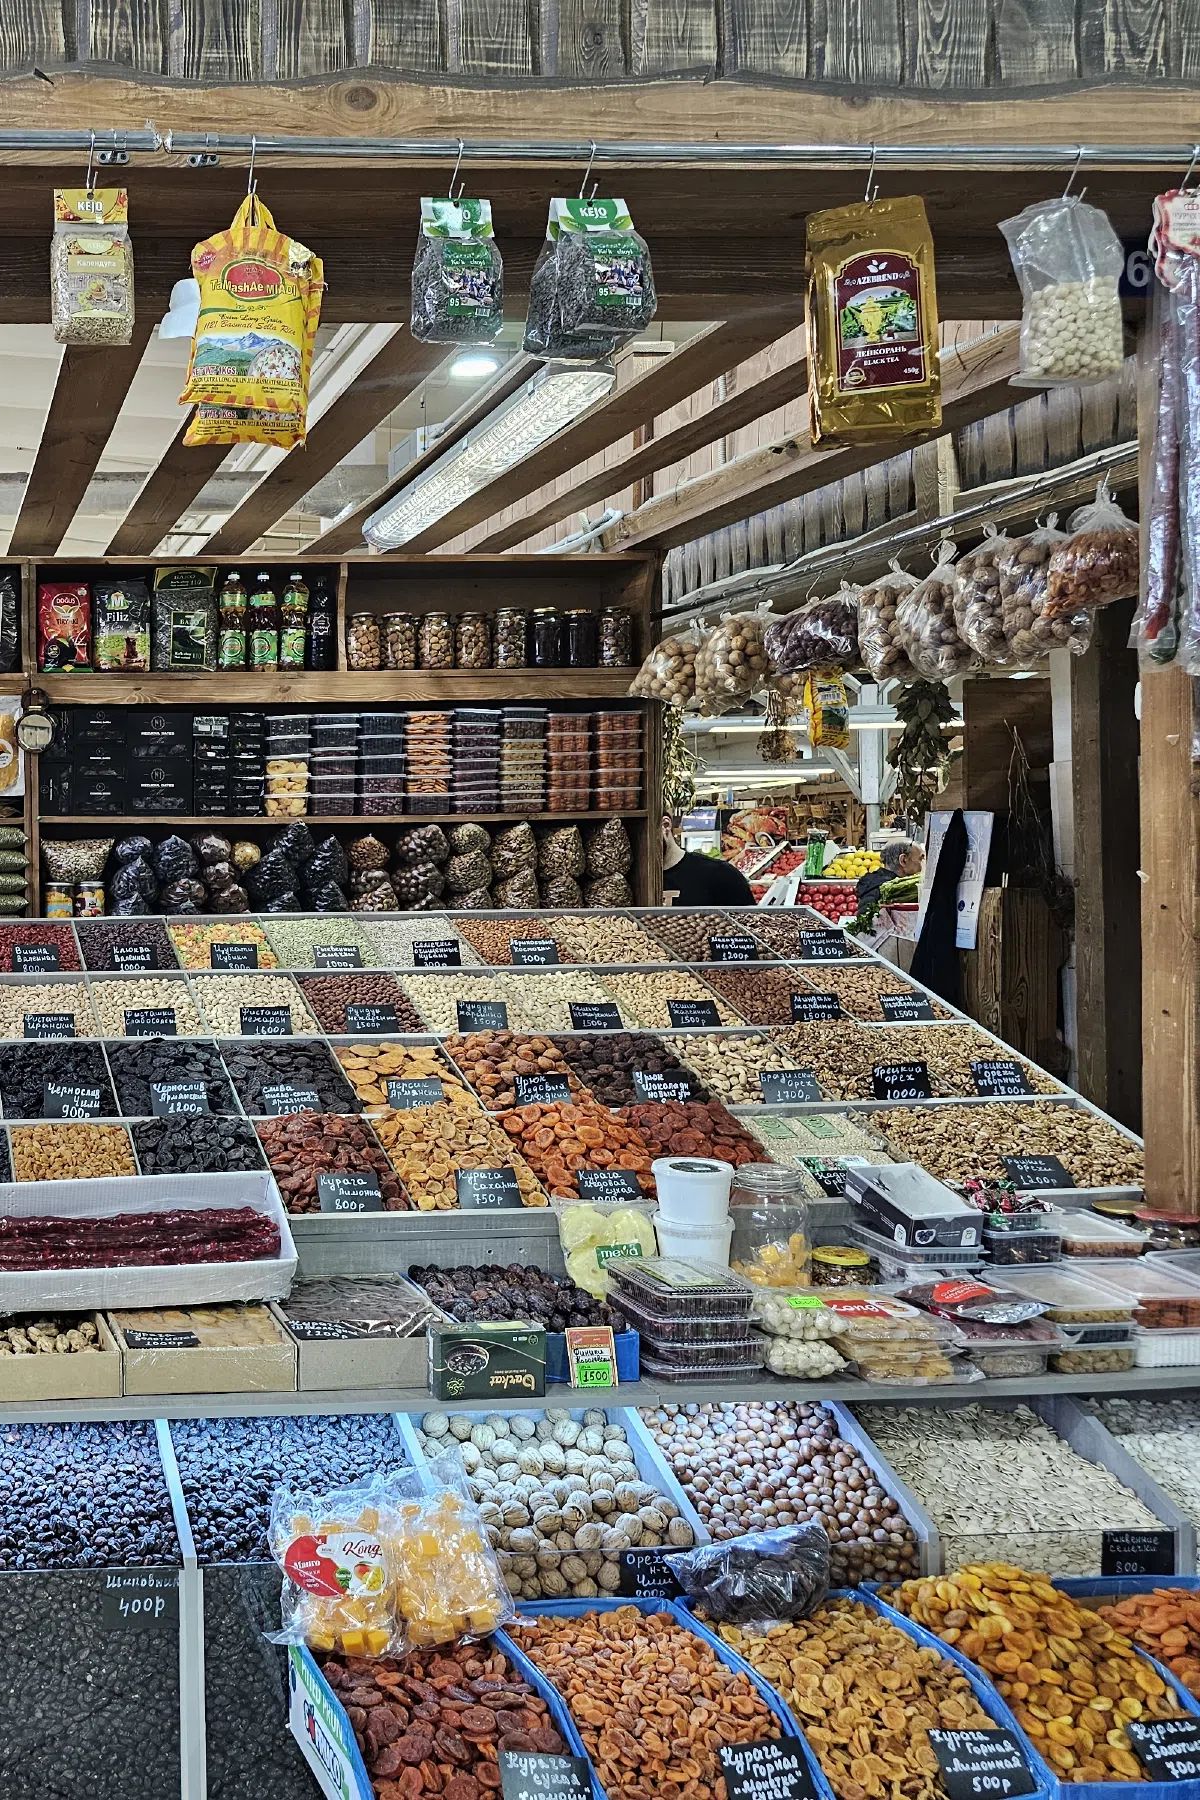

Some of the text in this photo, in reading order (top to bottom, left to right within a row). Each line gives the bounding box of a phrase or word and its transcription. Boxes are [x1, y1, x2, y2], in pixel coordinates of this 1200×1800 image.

[77, 201, 103, 214] KEJO
[579, 207, 607, 218] KEJO
[106, 612, 129, 622] Filiz
[812, 946, 843, 956] 2800р
[522, 954, 546, 964] 700р
[776, 1090, 811, 1102] 1700р
[886, 1088, 925, 1100] 1000р
[61, 1105, 90, 1119] 900р
[168, 1102, 202, 1114] 1200р
[472, 1193, 504, 1205] 750р
[583, 1370, 607, 1382] 1500
[119, 1597, 165, 1617] 400р
[1132, 1721, 1197, 1743] Курага
[929, 1729, 990, 1751] Курага
[505, 1753, 572, 1777] Курага
[722, 1744, 783, 1776] Курага
[972, 1775, 1011, 1793] 500р
